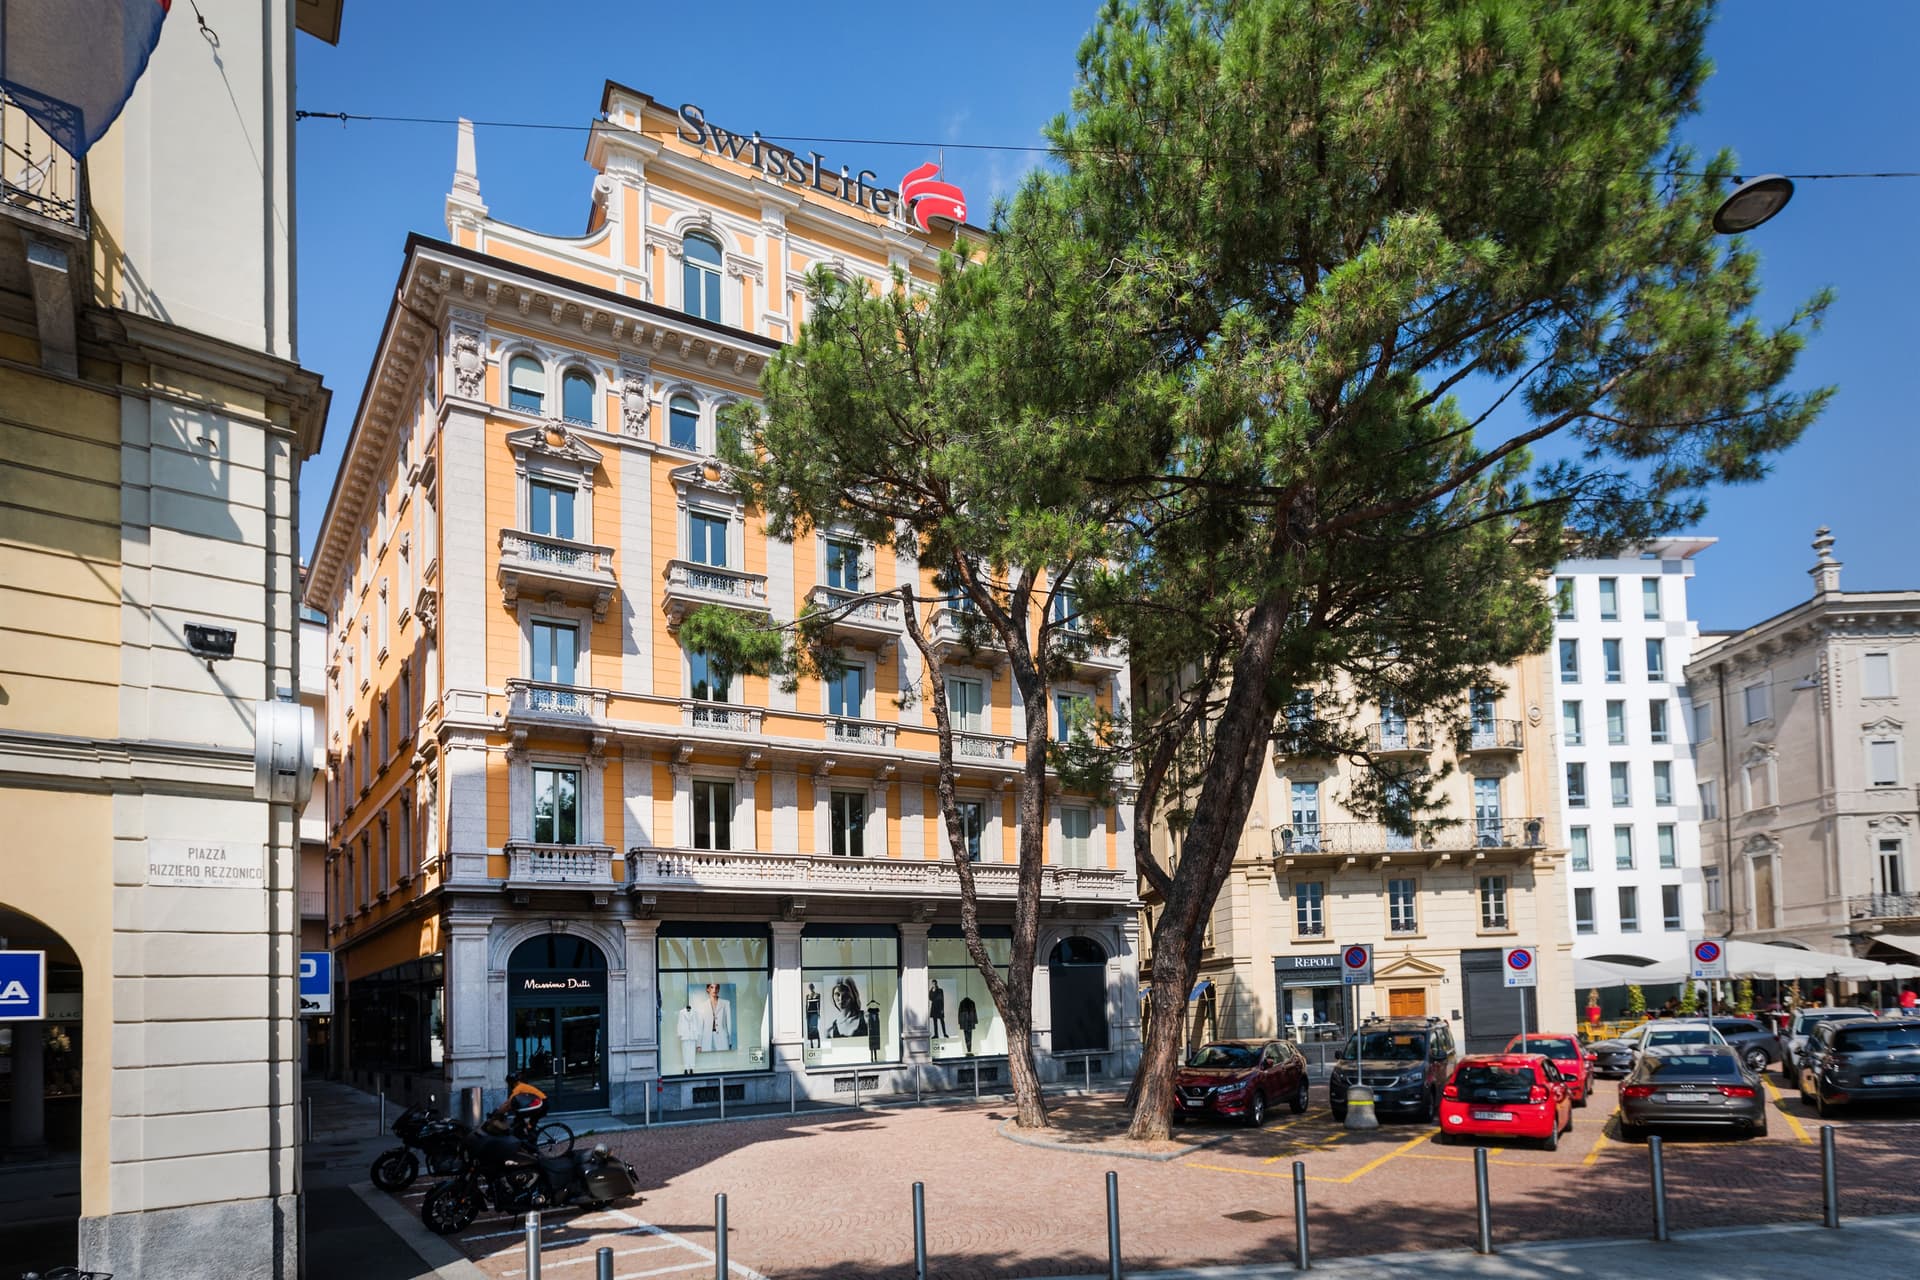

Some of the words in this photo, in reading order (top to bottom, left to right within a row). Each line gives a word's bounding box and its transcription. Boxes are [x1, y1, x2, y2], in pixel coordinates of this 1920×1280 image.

[188, 847, 226, 861] PIAZZA
[149, 863, 200, 878] RIZZIERO
[204, 865, 263, 880] REZZONICO
[524, 978, 566, 989] Massimo
[567, 978, 591, 989] Dutti
